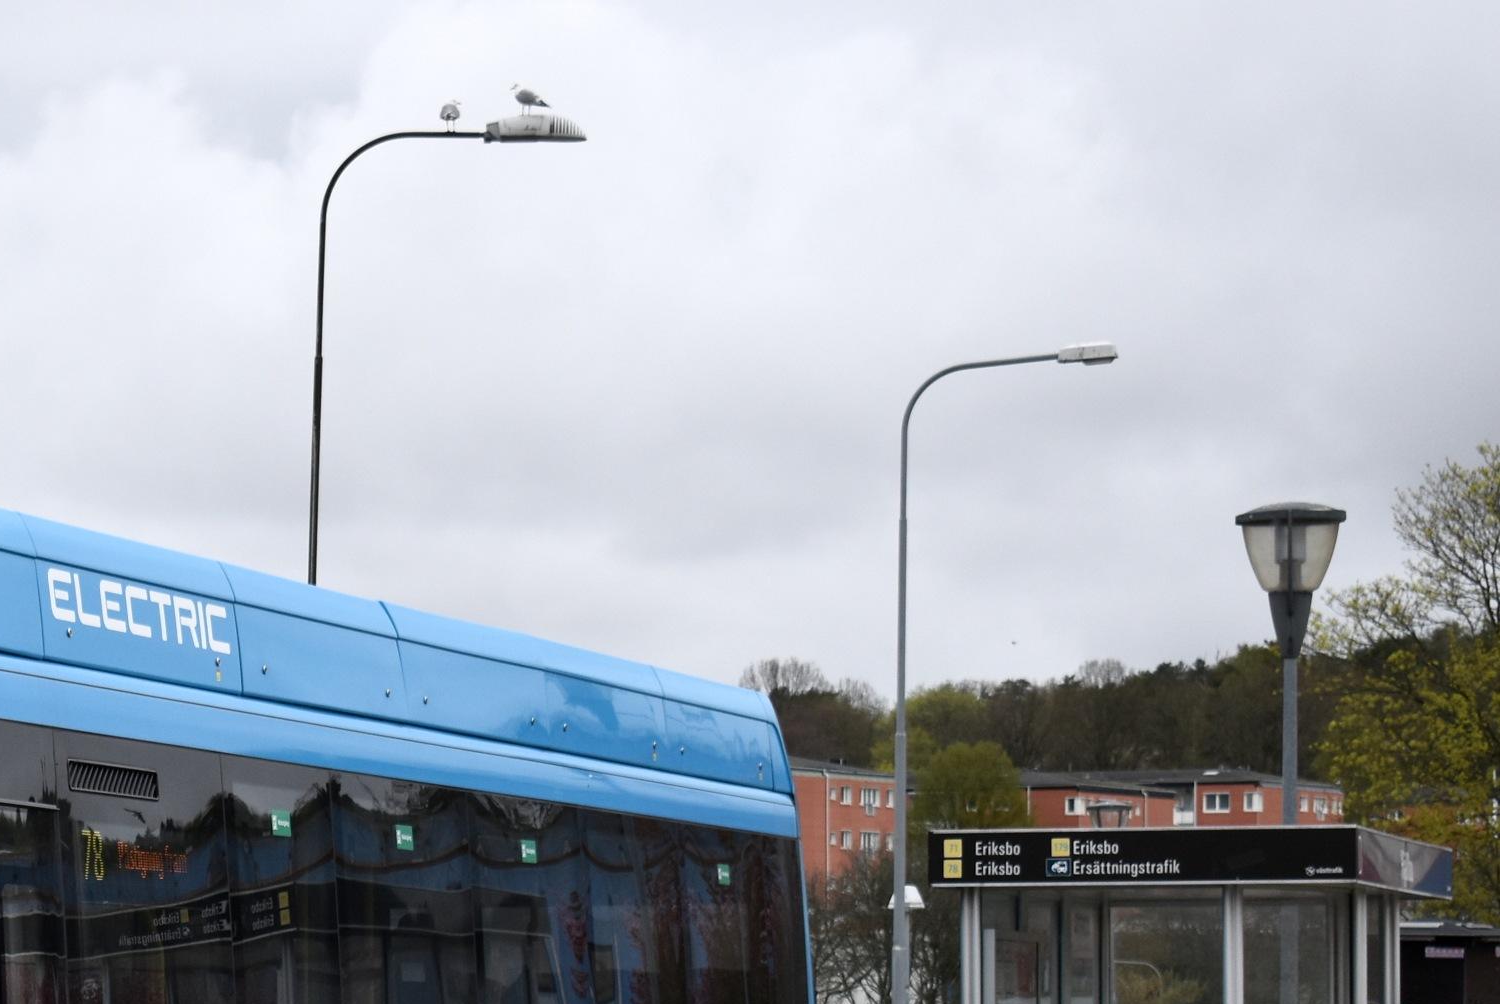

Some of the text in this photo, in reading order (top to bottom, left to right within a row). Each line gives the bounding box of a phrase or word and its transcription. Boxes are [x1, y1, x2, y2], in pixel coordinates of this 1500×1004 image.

[47, 567, 231, 655] ELECTRIC
[81, 829, 105, 880] 78
[975, 841, 1021, 856] Eriksbo
[1073, 840, 1119, 855] Eriksbo
[975, 861, 1021, 877] Eriksbo
[1073, 859, 1181, 878] Ersättningstrafik
